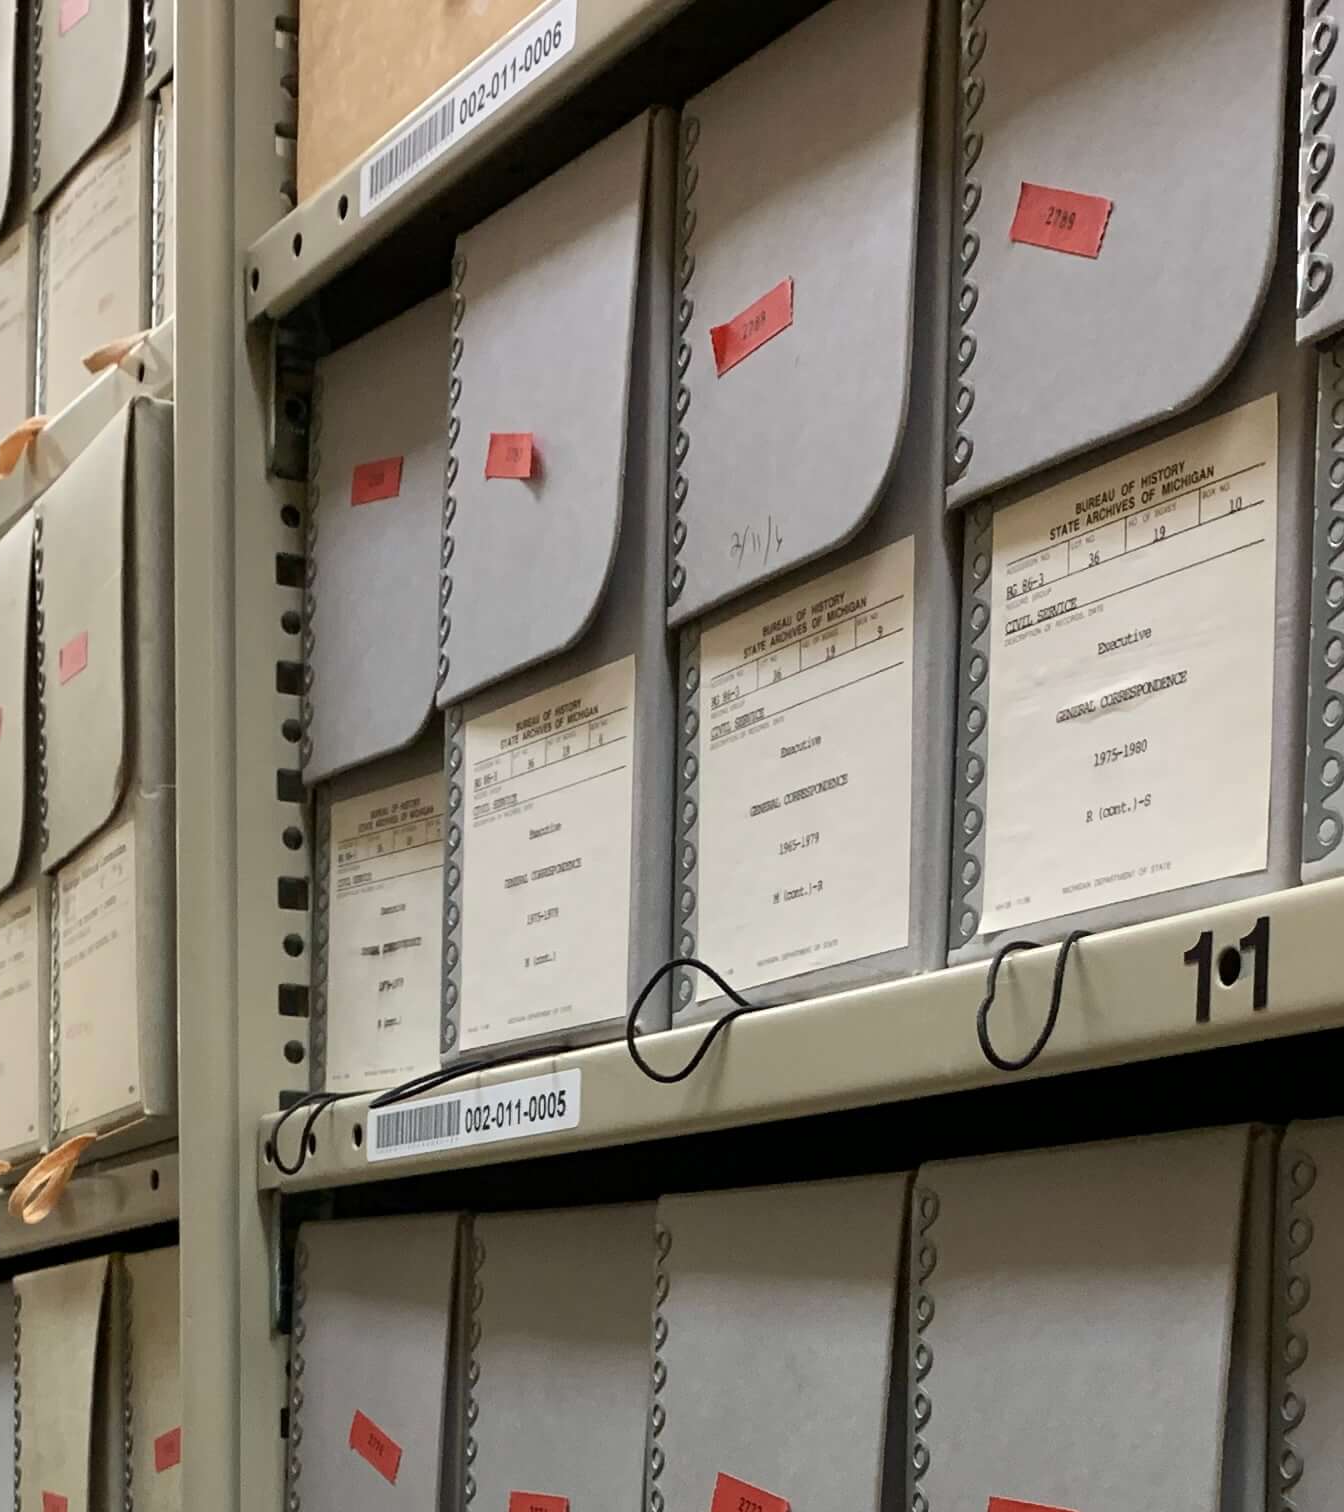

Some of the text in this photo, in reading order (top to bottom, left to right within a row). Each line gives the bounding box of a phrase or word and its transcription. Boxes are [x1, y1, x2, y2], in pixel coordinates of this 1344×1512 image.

[459, 20, 562, 124] 002-011-0006
[1045, 206, 1076, 230] 2789
[1076, 461, 1185, 515] BUREAU OF HISTORY
[1049, 465, 1215, 541] STATE ARCHIVES OF MICHIGAN
[1228, 496, 1243, 514] 10
[1153, 525, 1166, 543] 19
[1088, 551, 1100, 568] 36
[762, 592, 846, 637] BUREAU OF HISTORY
[827, 598, 867, 623] MICHIGAN
[1005, 596, 1078, 634] CIVIL SERVICE
[1097, 627, 1152, 656] Executive
[1056, 670, 1188, 724] GENERAL CORRESPONDENCE
[1094, 738, 1148, 767] 1975-1980
[1099, 793, 1152, 821] (cont.)-S
[465, 1090, 566, 1133] 002-011-0005
